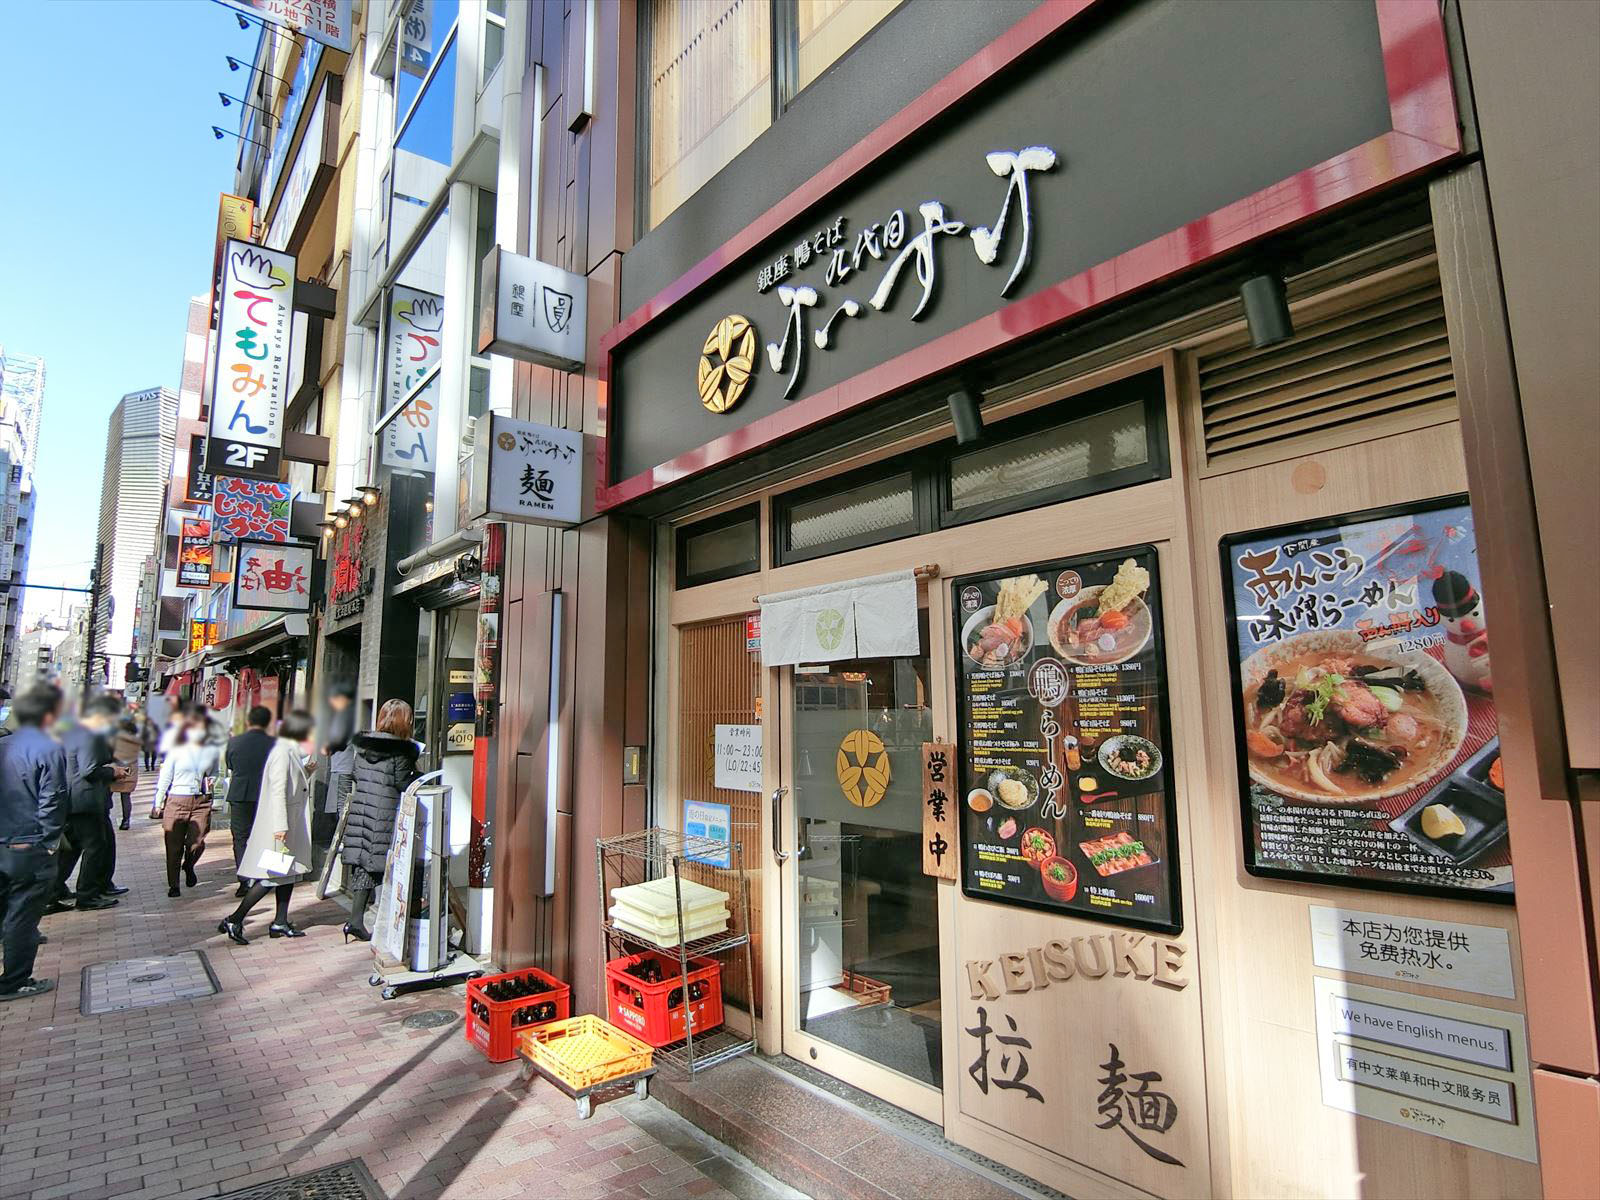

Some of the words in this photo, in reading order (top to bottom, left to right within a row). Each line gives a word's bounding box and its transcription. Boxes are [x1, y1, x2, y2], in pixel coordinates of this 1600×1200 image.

[272, 304, 286, 350] Always
[229, 290, 273, 436] てもみん
[268, 356, 283, 427] Relaxation
[225, 443, 270, 469] 2F
[227, 478, 285, 500] 九州
[519, 463, 555, 502] 麺
[214, 492, 271, 519] じゃん
[519, 500, 555, 510] RAMEN
[223, 516, 289, 542] がら
[1238, 547, 1364, 607] あんこう
[1250, 579, 1417, 643] 味噌らーめん
[927, 750, 949, 867] 営業中
[1342, 918, 1470, 953] 本店为您提供
[1359, 940, 1453, 970] 免费热水。
[965, 931, 1190, 1001] KEISUKE
[1341, 1008, 1361, 1024] We
[1364, 1013, 1394, 1030] have
[1397, 1020, 1444, 1042] English
[1447, 1032, 1498, 1052] menus.
[1346, 1057, 1502, 1107] 有中文菜单和中文服务员
